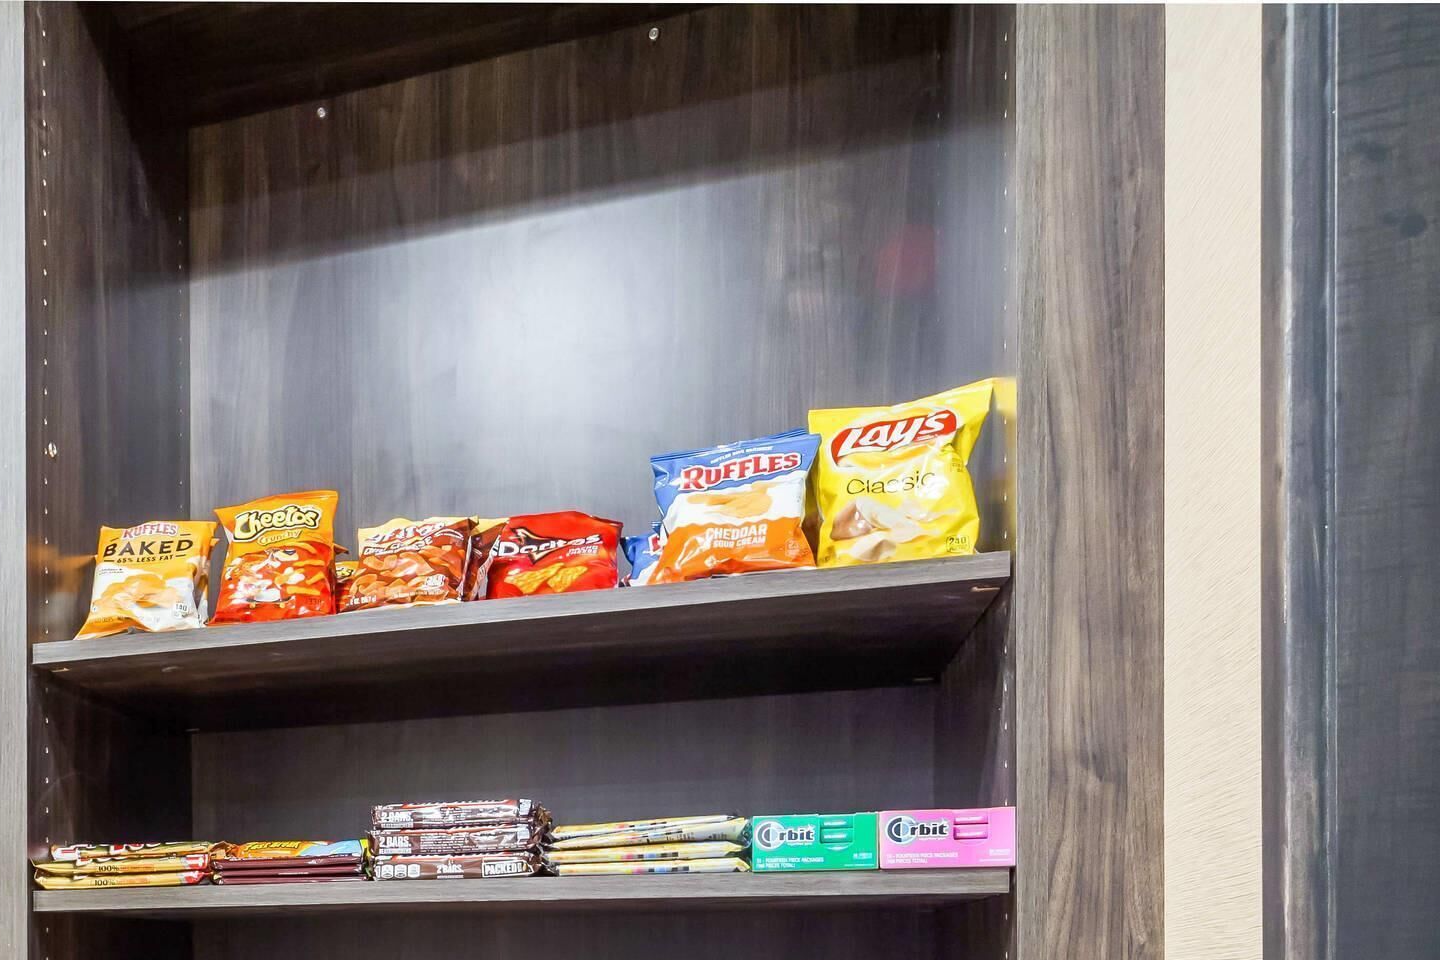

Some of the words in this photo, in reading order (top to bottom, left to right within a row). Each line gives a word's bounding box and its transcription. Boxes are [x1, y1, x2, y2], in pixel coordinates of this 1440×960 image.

[680, 452, 801, 490] RUFFLES
[846, 470, 936, 495] Classic
[123, 523, 178, 539] RUFFLES
[234, 505, 321, 541] Cheetos
[706, 523, 768, 542] CHEDDAR
[103, 539, 194, 557] BAKED
[498, 534, 602, 557] Doritos
[713, 540, 734, 548] SOUR
[736, 535, 766, 547] CREAM
[756, 821, 815, 848] Orbit
[886, 816, 949, 844] Orbit
